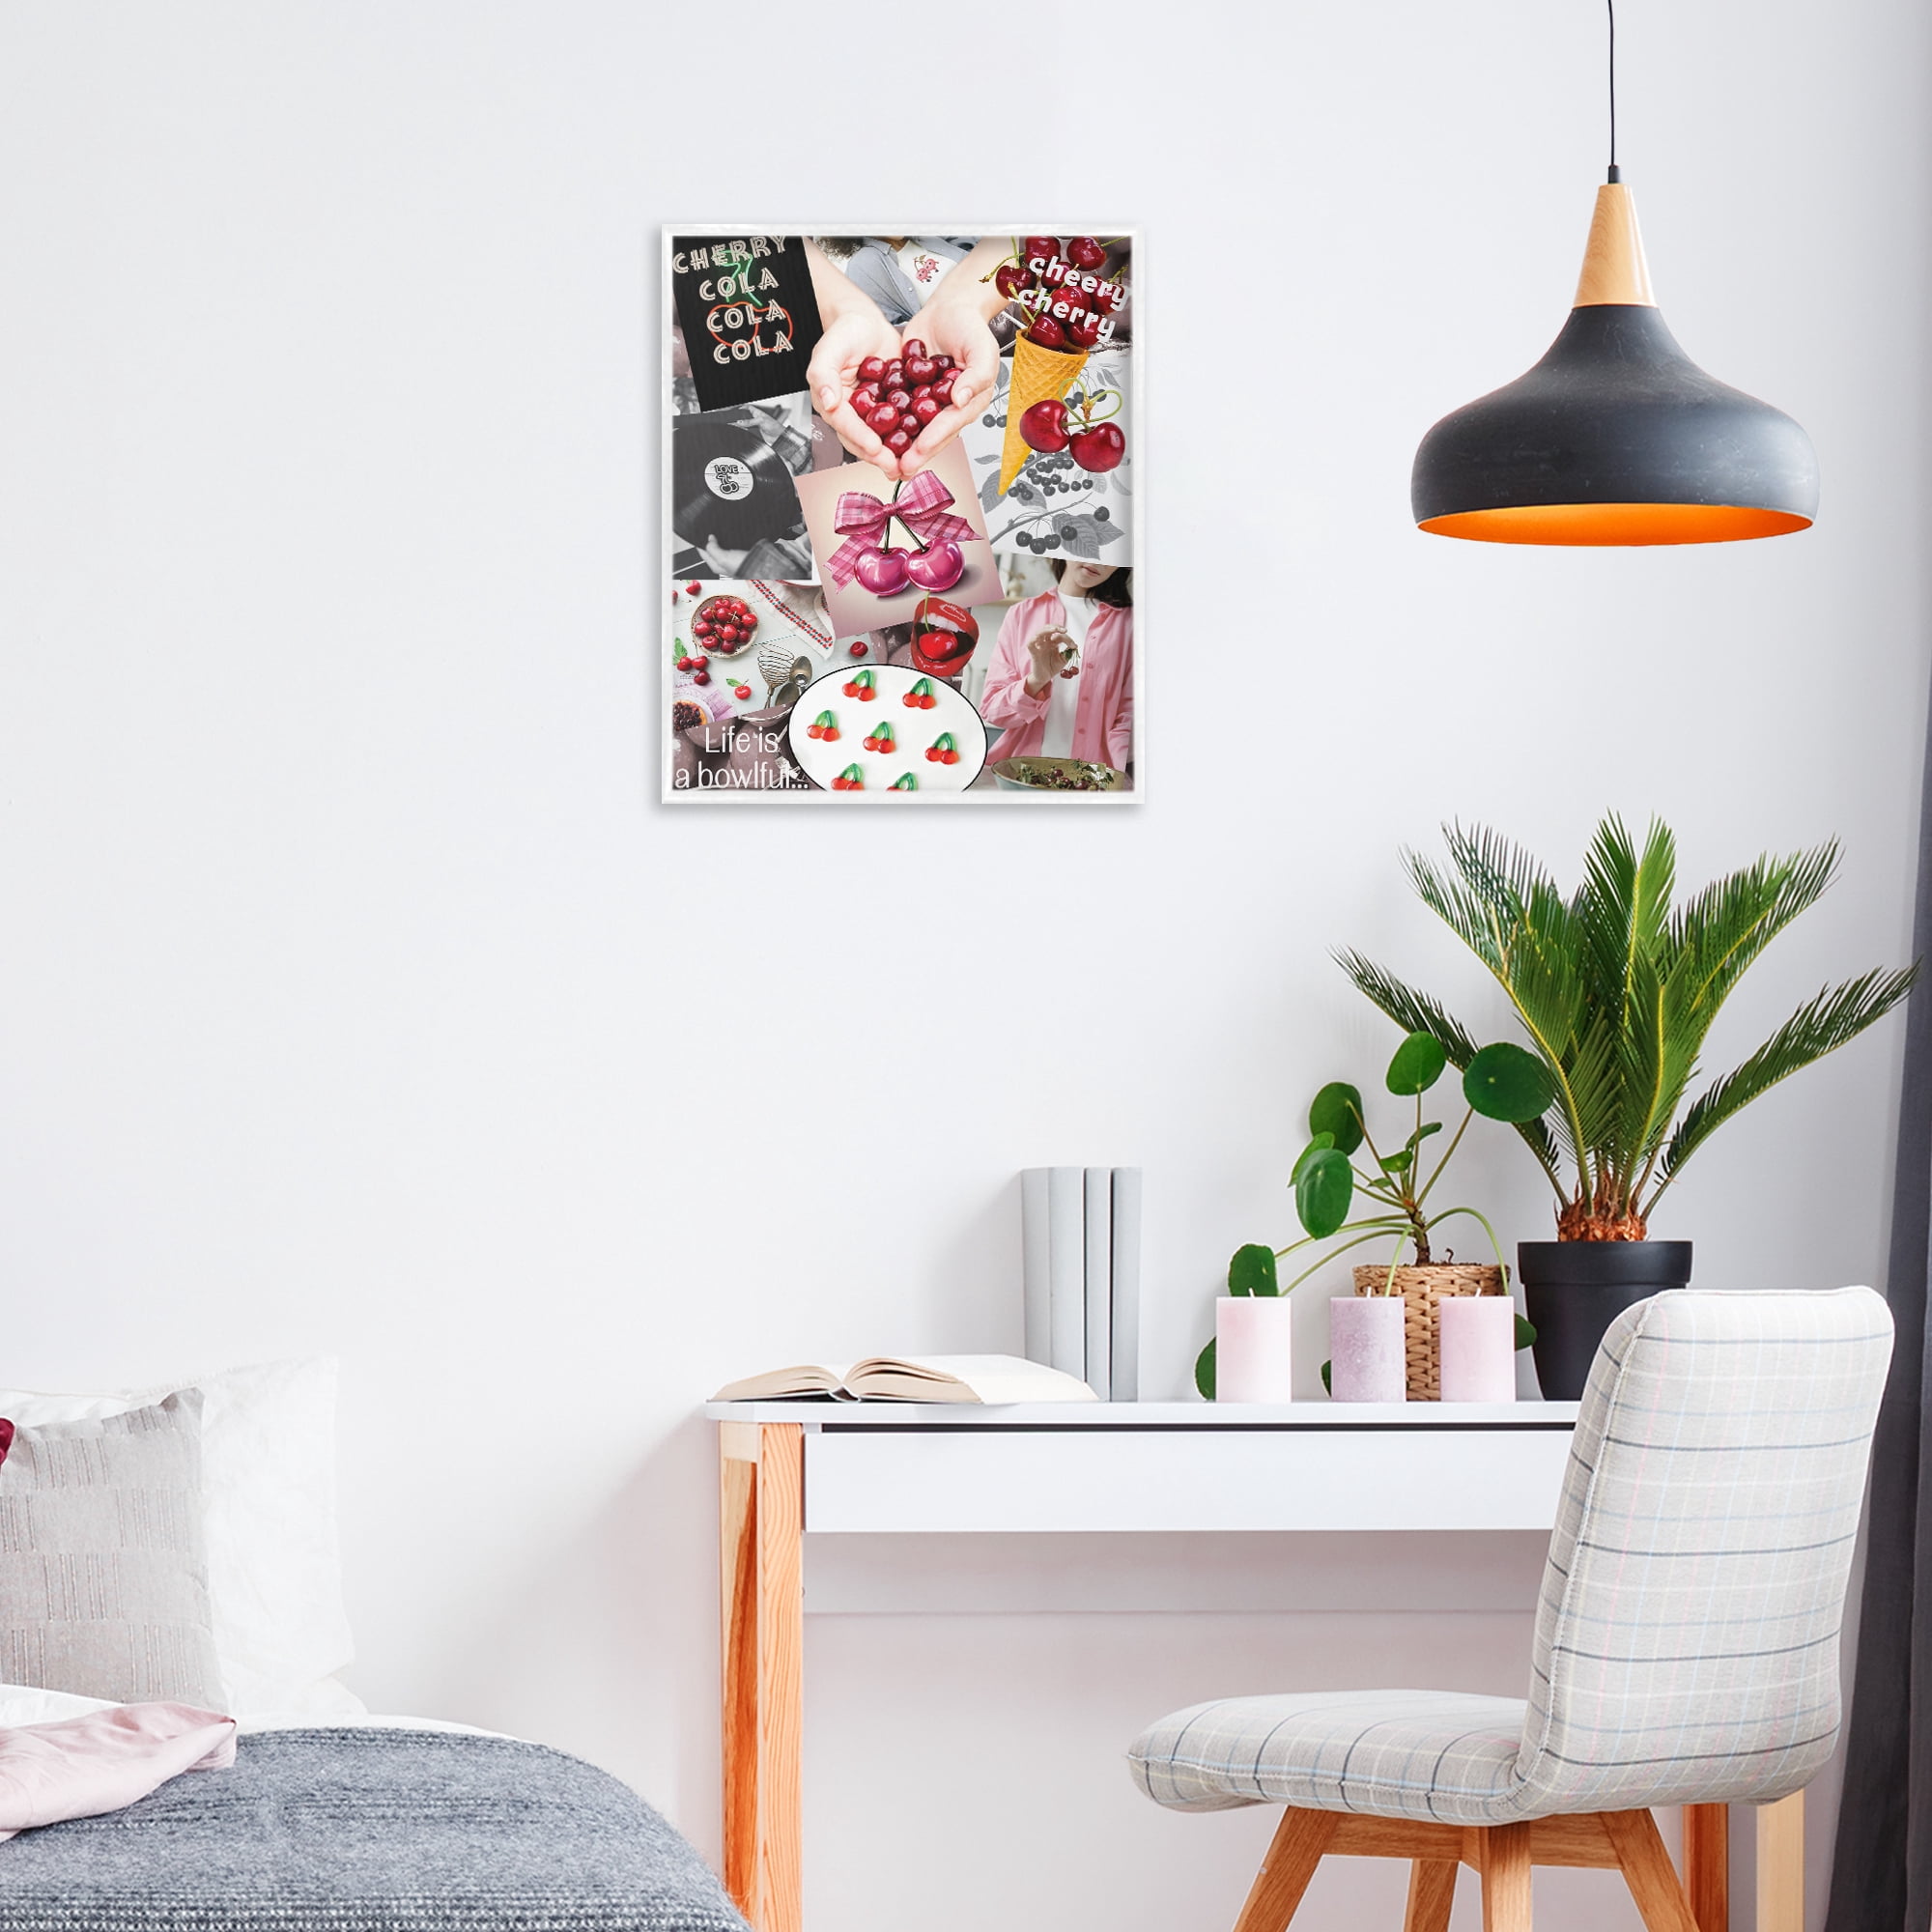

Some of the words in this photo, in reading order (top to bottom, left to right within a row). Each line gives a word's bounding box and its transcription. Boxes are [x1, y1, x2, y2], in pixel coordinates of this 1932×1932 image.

[672, 236, 786, 274] CHERRY
[698, 267, 780, 301] COLA
[1029, 256, 1129, 312] cheery
[706, 298, 786, 333] COLA
[1018, 288, 1116, 343] cherry
[713, 330, 794, 365] COLA
[714, 464, 739, 474] LOVE
[705, 726, 751, 753] Life
[758, 726, 779, 753] is
[675, 768, 690, 789] a
